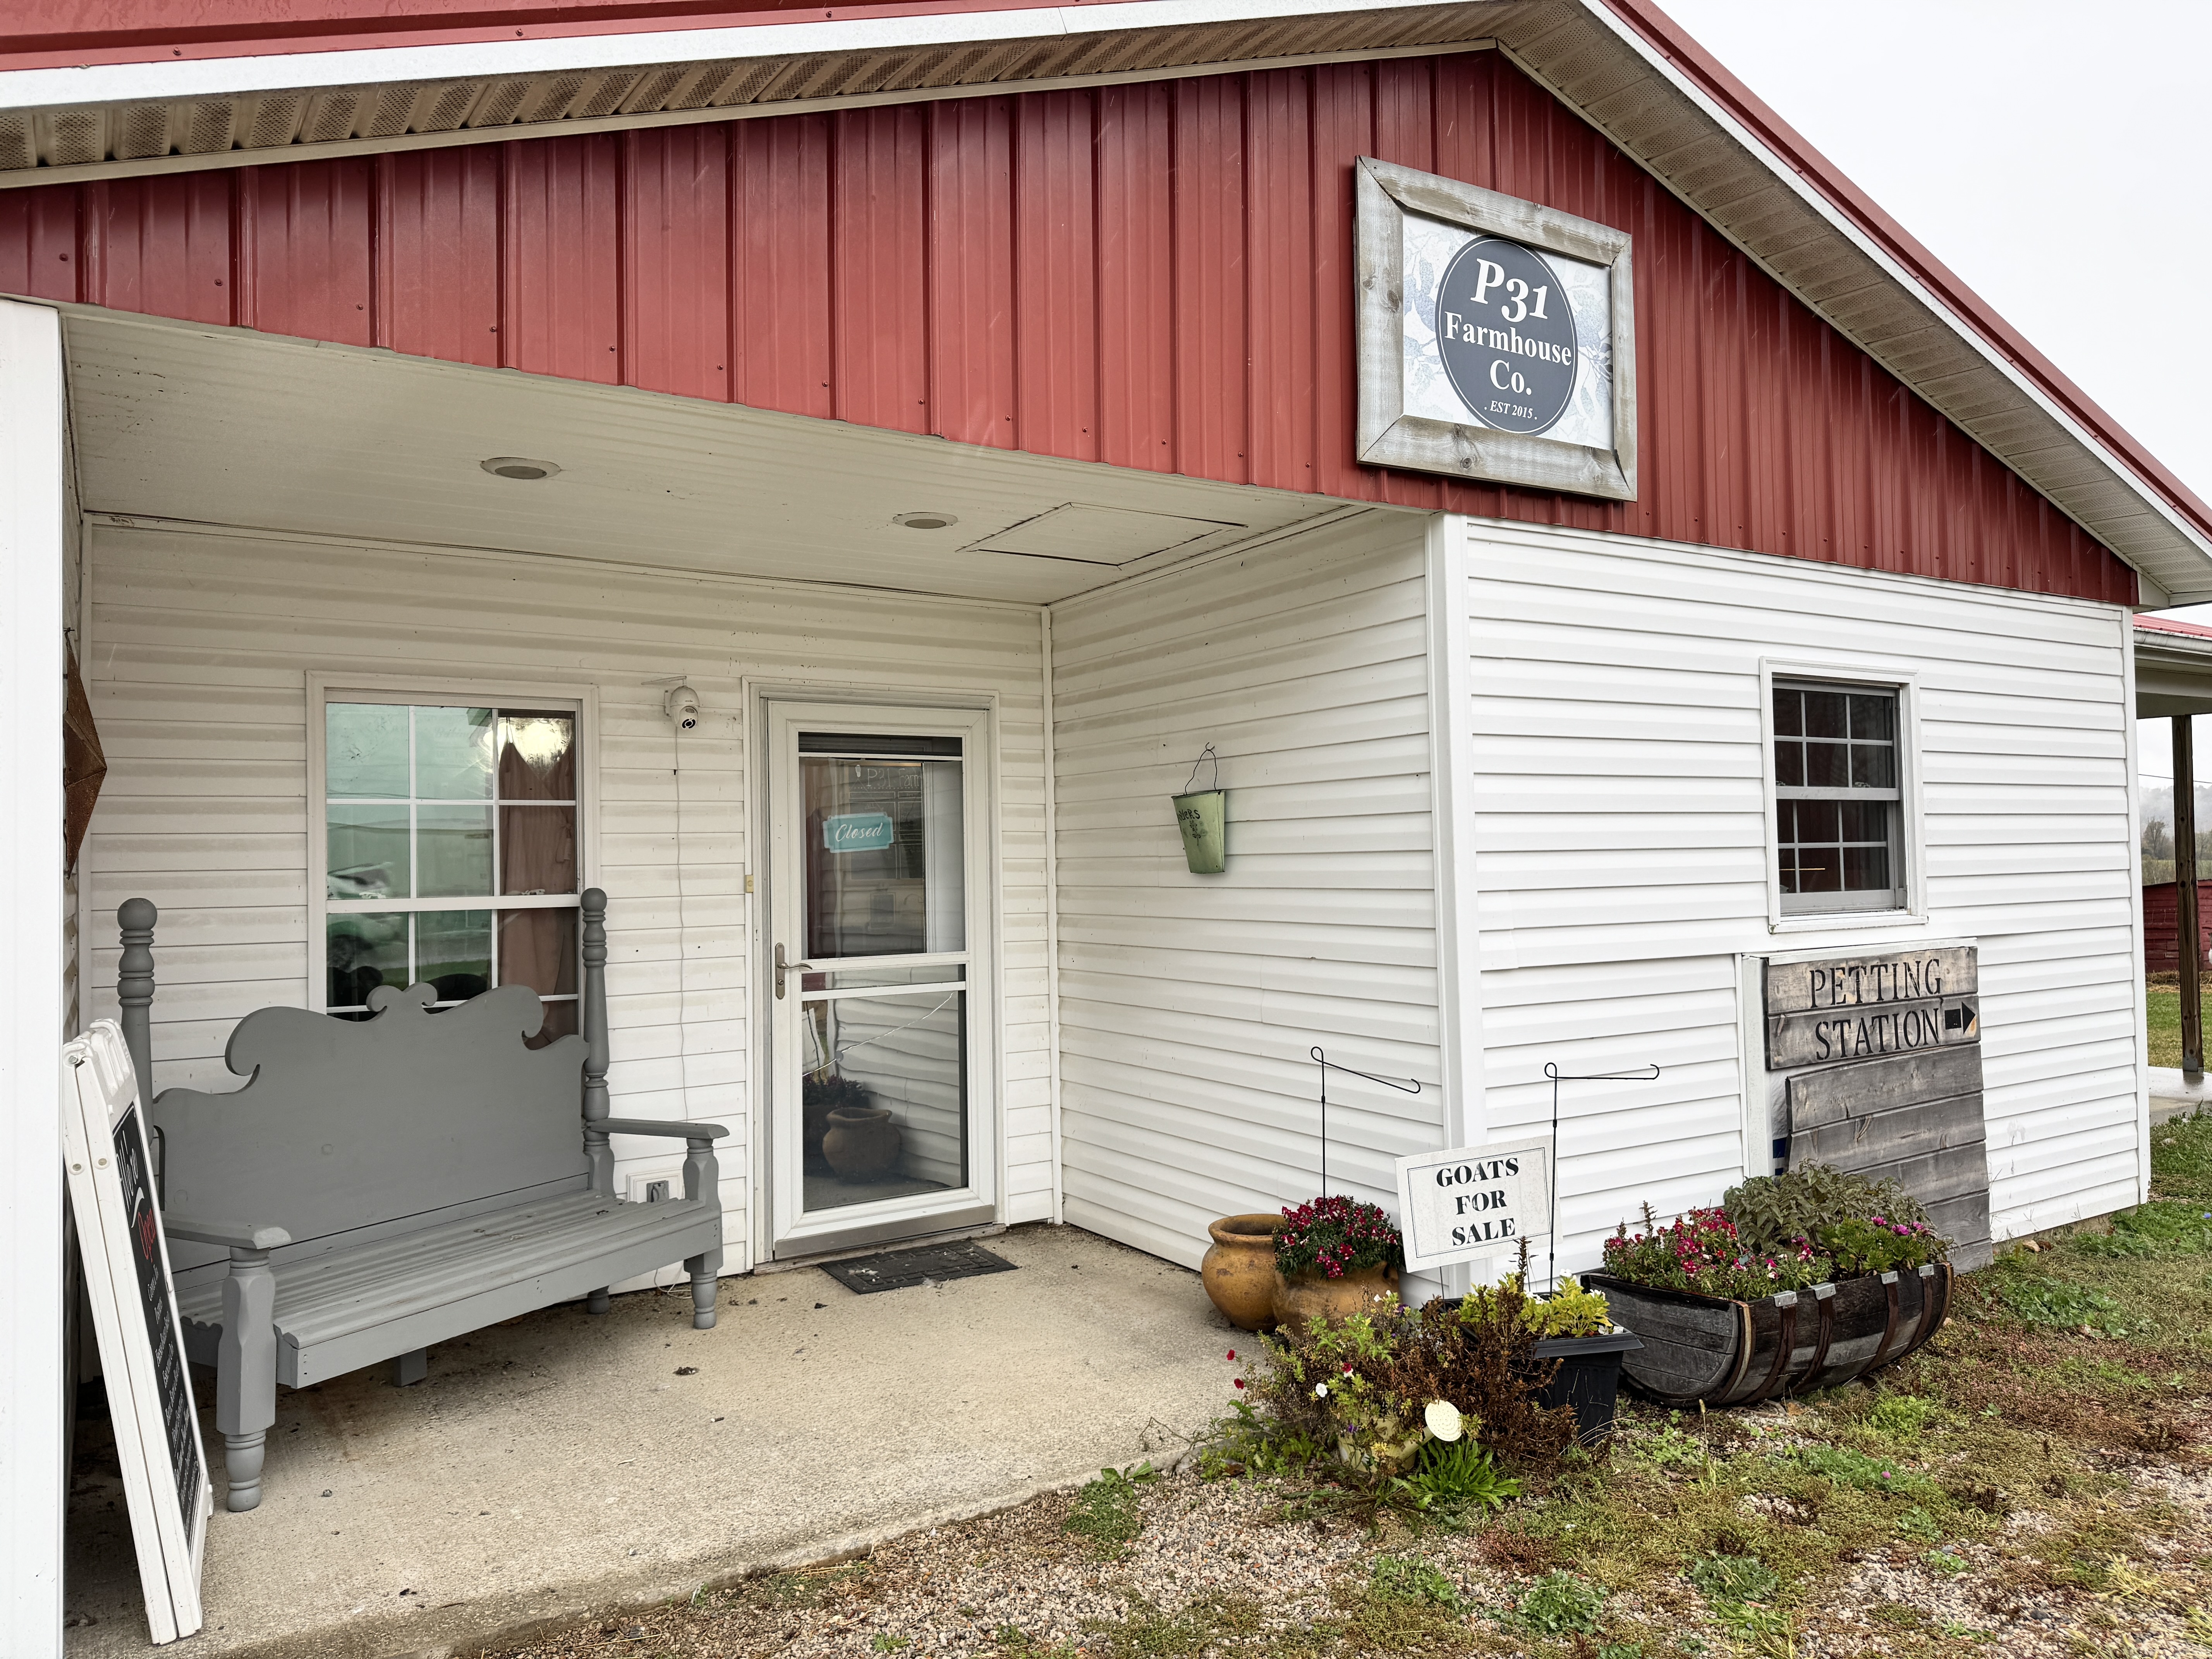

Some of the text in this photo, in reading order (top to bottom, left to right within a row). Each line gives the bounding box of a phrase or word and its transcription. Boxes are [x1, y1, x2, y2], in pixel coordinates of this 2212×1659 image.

[1470, 258, 1549, 322] P31
[1444, 311, 1572, 366] Farmhouse
[1489, 360, 1532, 396] Co.
[1490, 400, 1510, 415] EST
[835, 822, 884, 842] Closed
[1809, 958, 1941, 1008] PETTING
[1816, 1008, 1940, 1061] STATION
[1436, 1158, 1519, 1187] GOATS
[1455, 1190, 1507, 1215] FOR
[138, 1208, 156, 1264] Open
[1452, 1218, 1515, 1246] SALE
